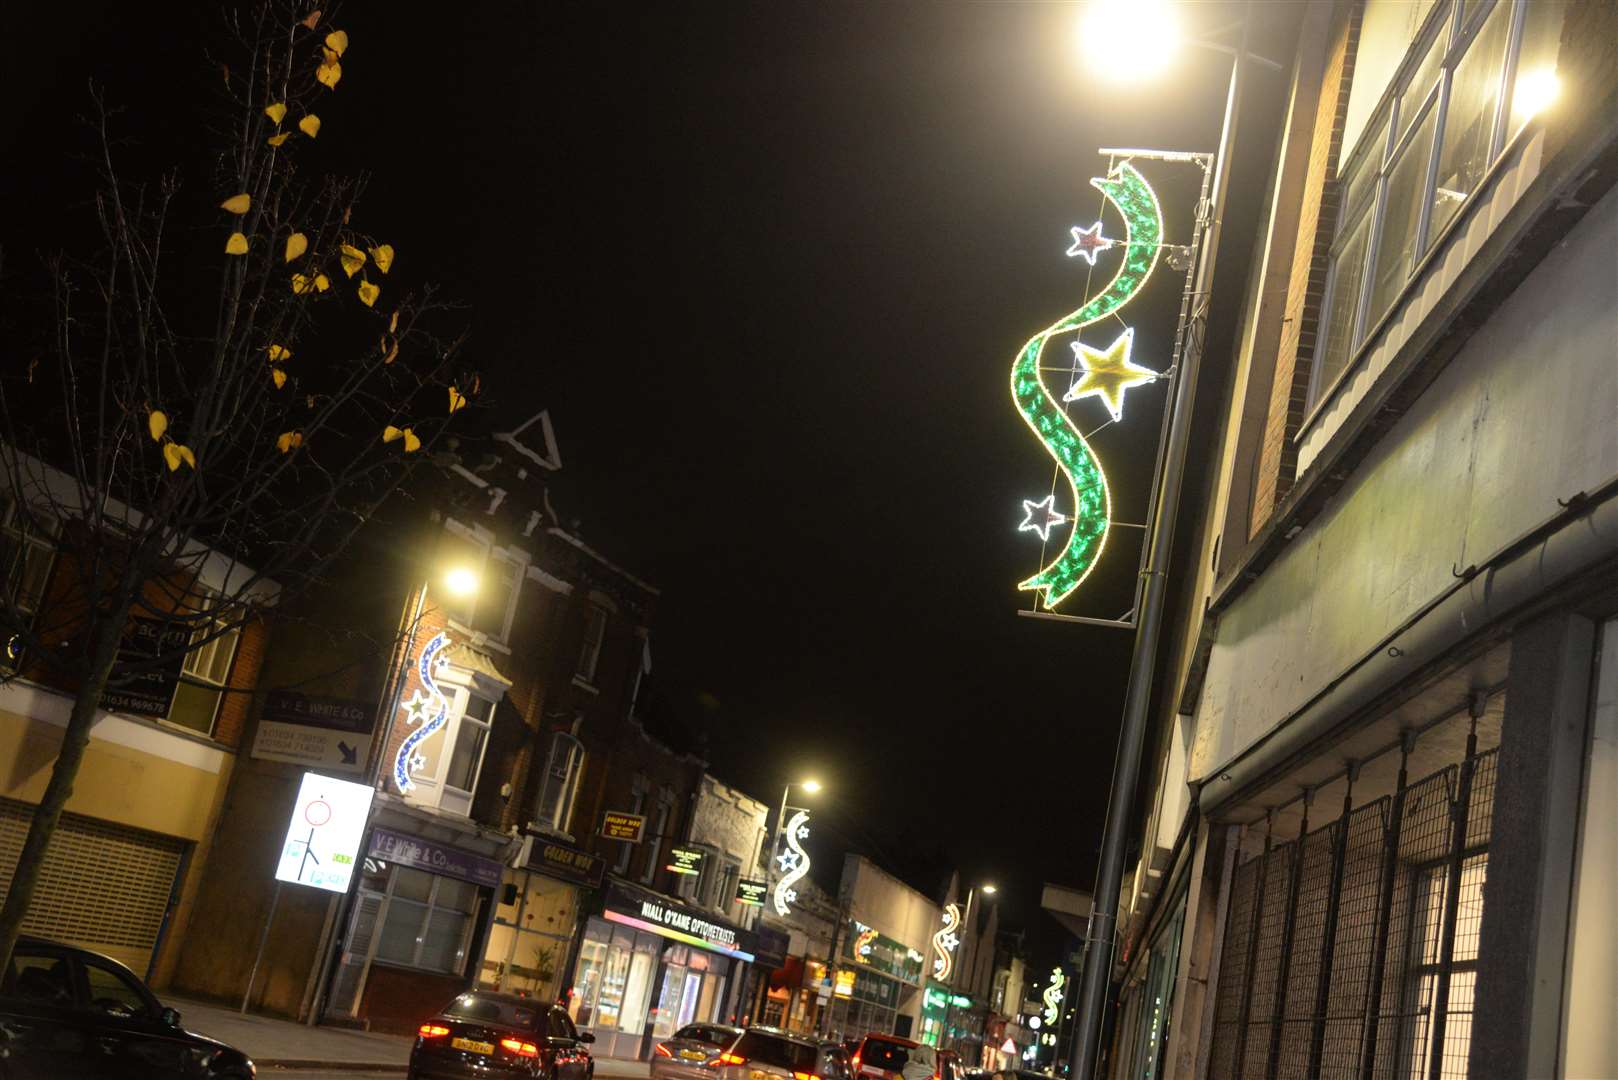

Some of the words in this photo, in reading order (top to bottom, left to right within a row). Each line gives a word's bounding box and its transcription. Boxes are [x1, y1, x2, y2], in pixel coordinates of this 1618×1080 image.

[376, 832, 385, 849] V
[386, 836, 394, 851] E
[422, 847, 430, 862] &
[641, 902, 663, 922] NIALL
[664, 909, 691, 932] O'KANE
[690, 915, 736, 943] OPTOMETRISTS
